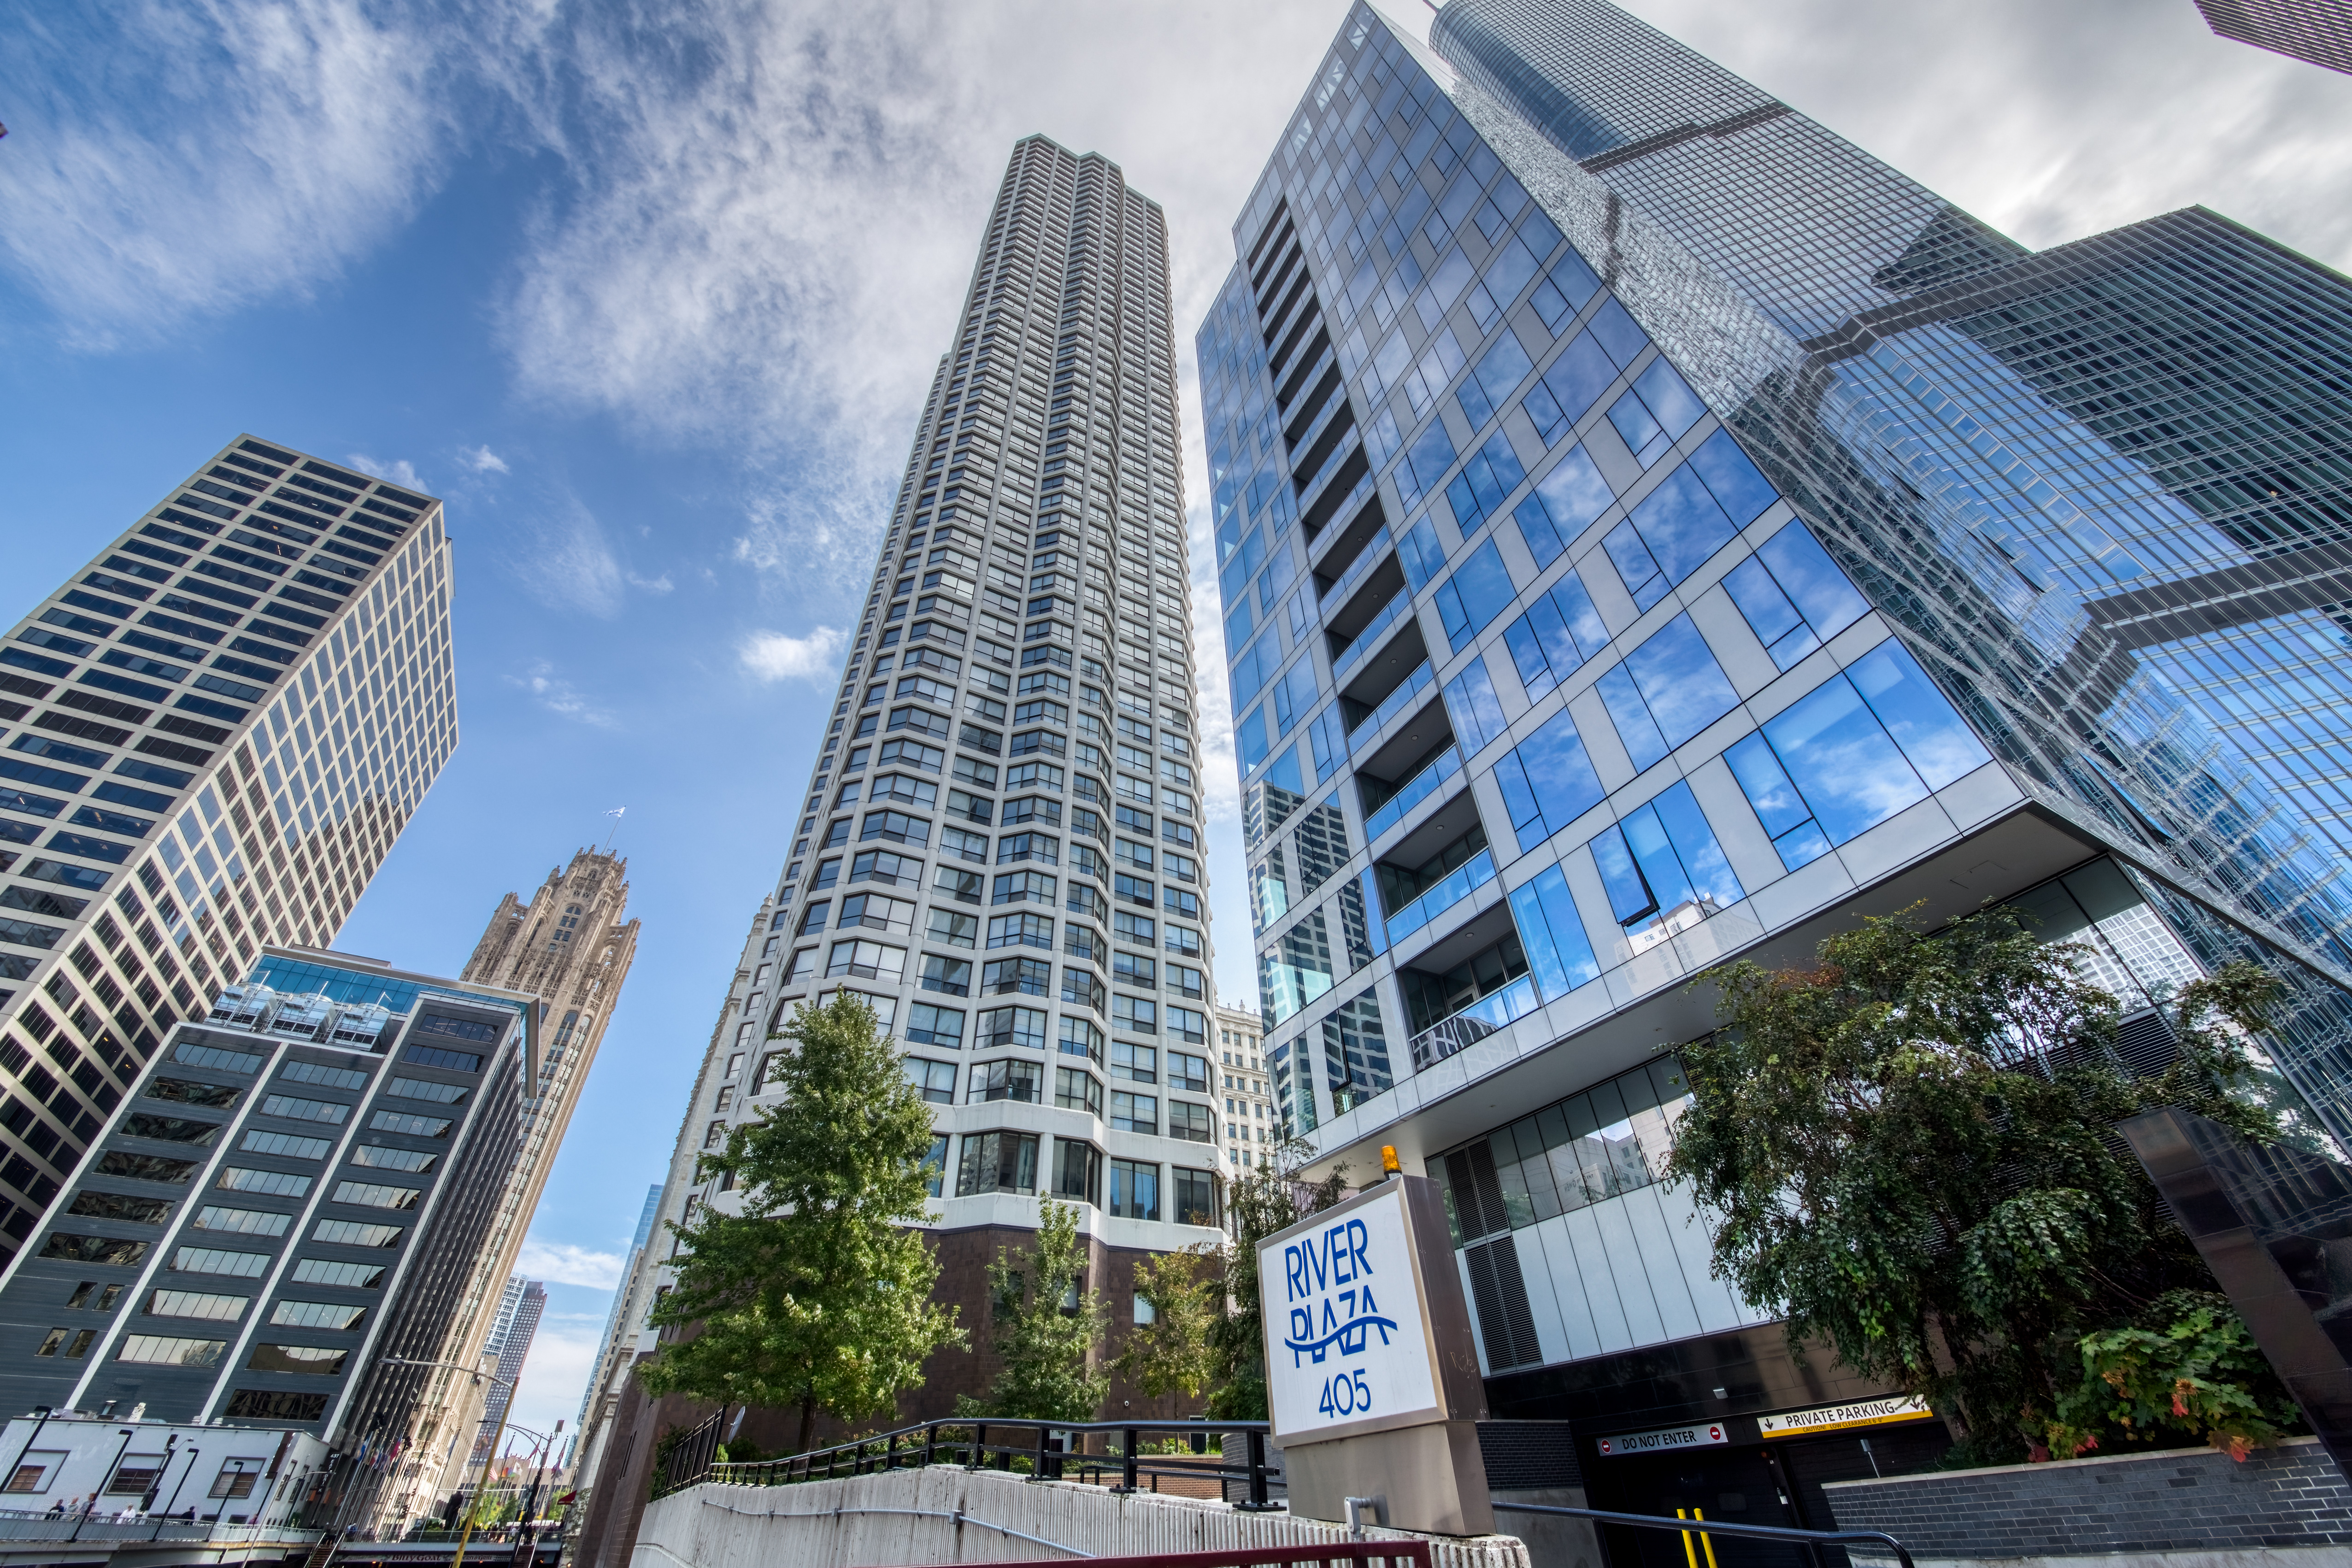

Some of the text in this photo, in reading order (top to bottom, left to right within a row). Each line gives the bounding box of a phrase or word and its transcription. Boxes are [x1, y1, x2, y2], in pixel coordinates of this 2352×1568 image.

[1285, 1218, 1373, 1303] RIVER
[1290, 1284, 1390, 1368] PLAZA
[1319, 1368, 1371, 1419] 405
[1785, 1401, 1896, 1427] PRIVATE PARKING
[1843, 1419, 1872, 1427] CLEARANCE
[1622, 1430, 1697, 1450] DO NOT ENTER
